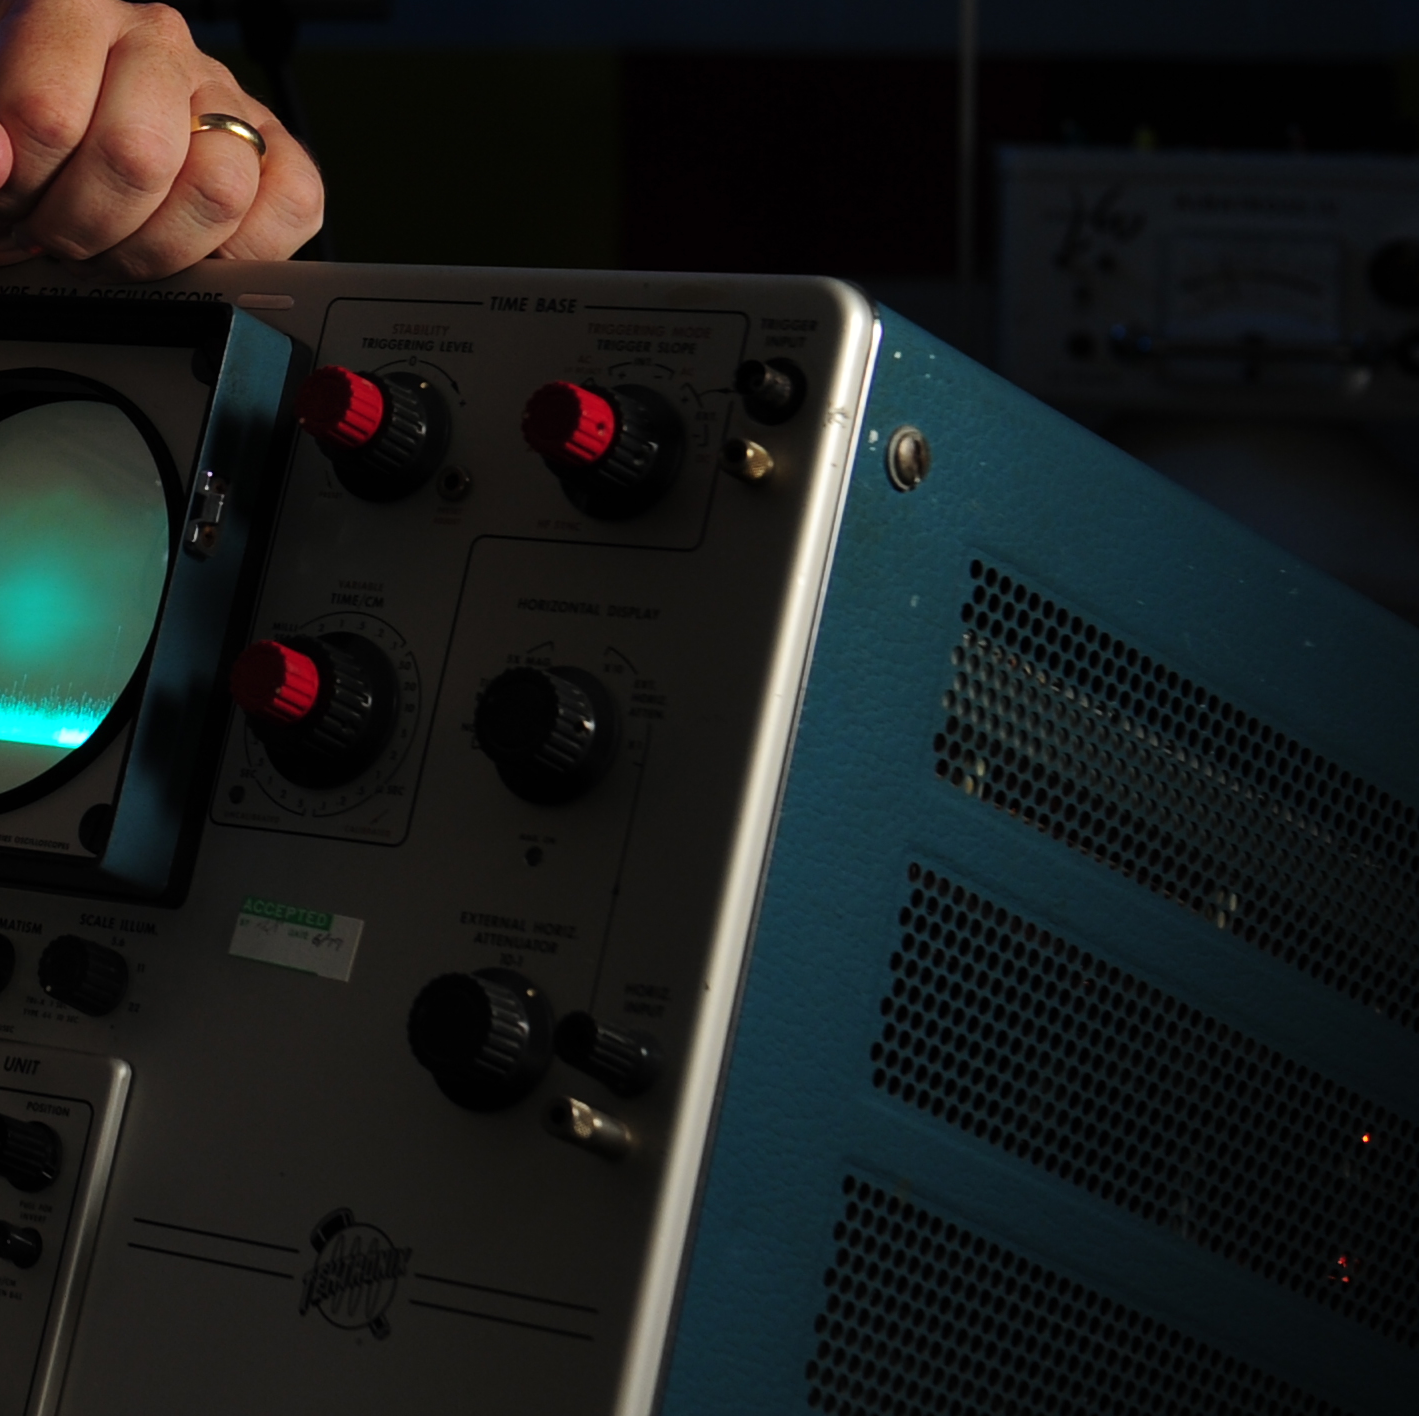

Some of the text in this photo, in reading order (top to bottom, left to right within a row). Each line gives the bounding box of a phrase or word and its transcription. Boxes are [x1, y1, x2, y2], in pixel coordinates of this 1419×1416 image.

[489, 296, 577, 314] TIME BASE
[392, 323, 450, 336] STABILITY
[587, 322, 712, 339] TRIGGERING MODE
[760, 318, 818, 332] TRIGGER
[362, 337, 475, 353] TRIGGERING LEVEL
[597, 339, 697, 355] TRIGGER SLOPE
[765, 336, 807, 349] INPUT
[338, 580, 384, 593] VARIABLE
[330, 592, 384, 609] TIME/CM
[517, 598, 661, 621] HORIZONTAL DISPLAY
[242, 896, 329, 927] ACCEPTED
[79, 912, 159, 936] SCALE ILLUM.
[460, 911, 526, 933] EXTERNAL
[473, 932, 559, 955] ATTENUATOR
[624, 1000, 665, 1018] INPUT
[3, 1056, 41, 1076] UNIT
[26, 1100, 70, 1117] POSITION
[298, 1247, 413, 1317] TEKTRONIX
